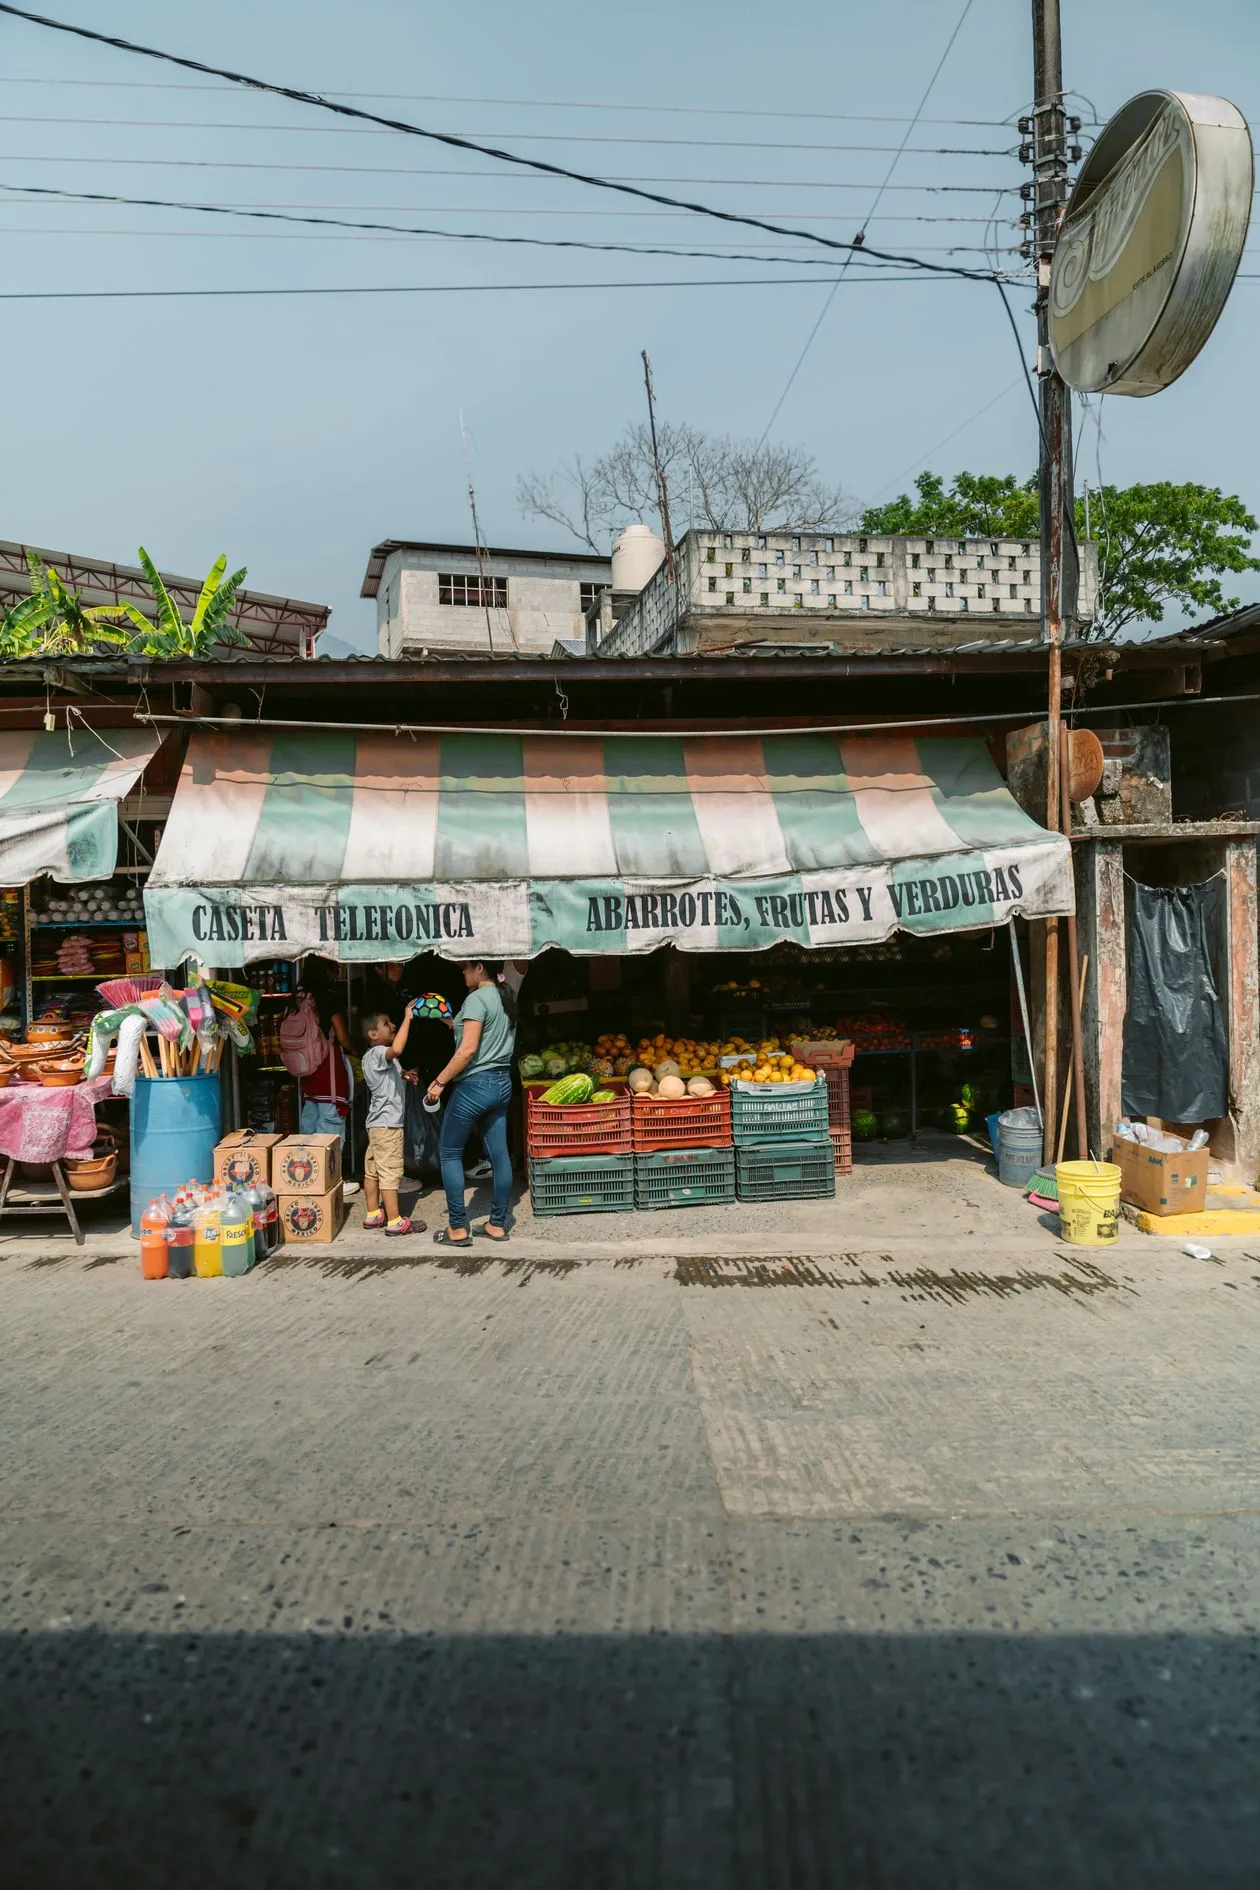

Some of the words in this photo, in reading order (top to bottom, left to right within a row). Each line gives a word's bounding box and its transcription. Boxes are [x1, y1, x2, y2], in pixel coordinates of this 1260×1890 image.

[586, 891, 750, 932] ABARROTES,
[754, 888, 850, 929] FRUTAS
[856, 886, 873, 922] Y
[886, 864, 1024, 918] VERDURAS
[191, 904, 288, 941] CASETA
[314, 902, 475, 941] TELEFONICA
[287, 1178, 314, 1188] MEXICO
[290, 1226, 318, 1237] MEXICO
